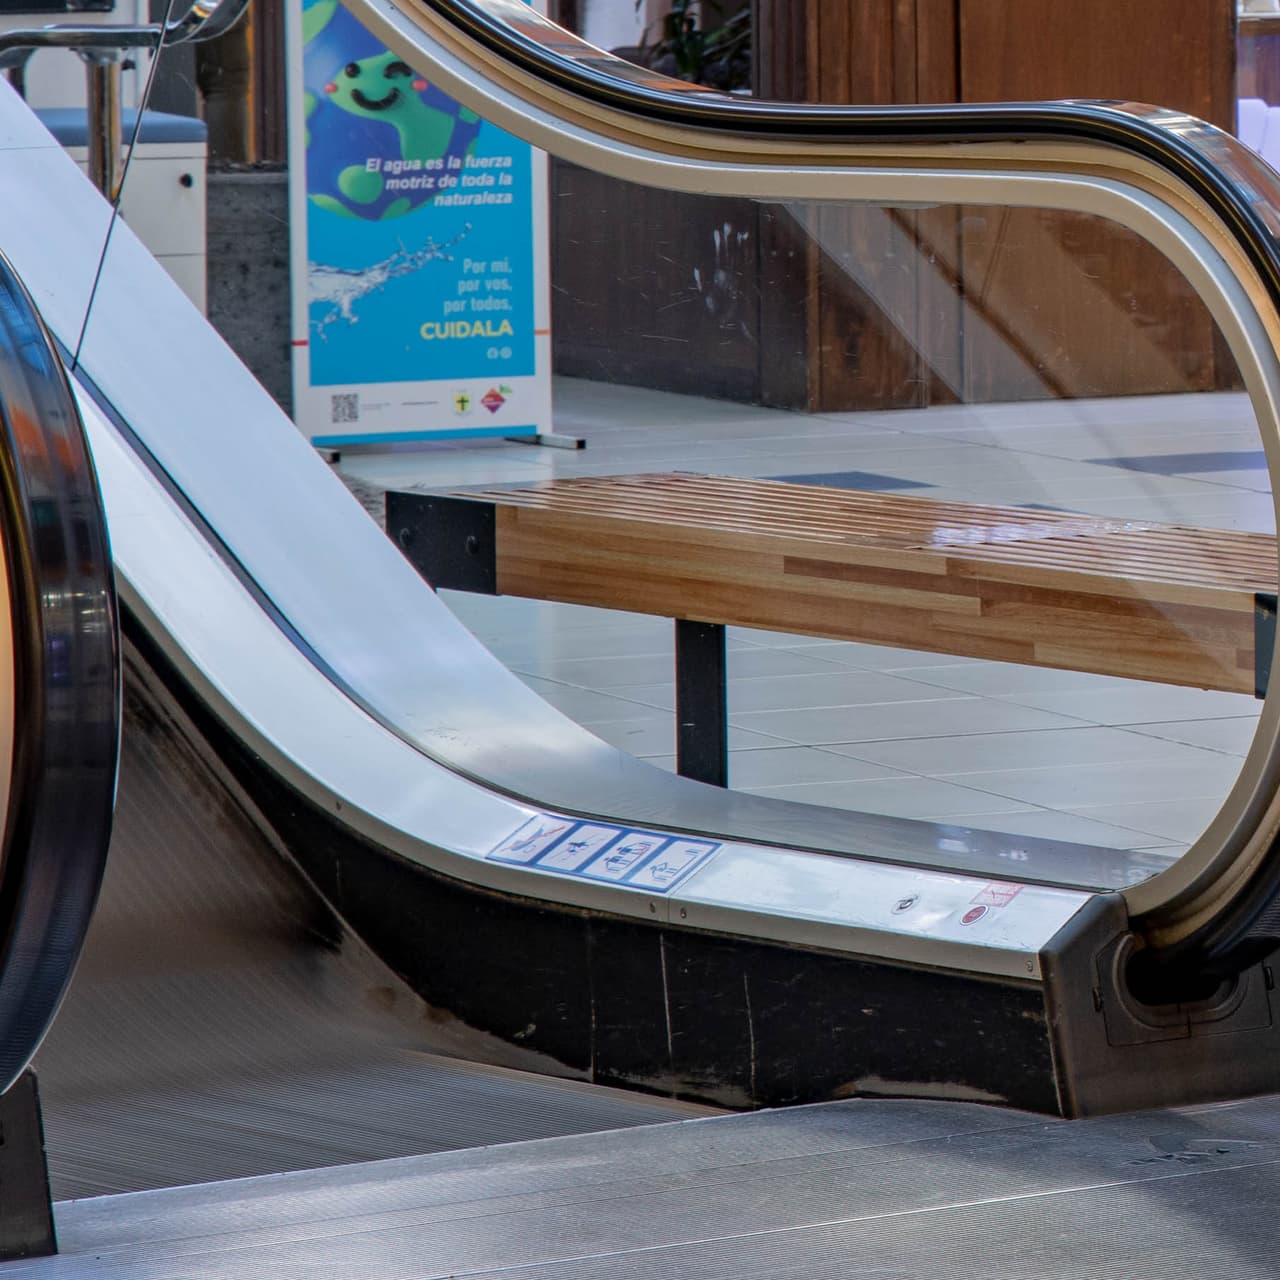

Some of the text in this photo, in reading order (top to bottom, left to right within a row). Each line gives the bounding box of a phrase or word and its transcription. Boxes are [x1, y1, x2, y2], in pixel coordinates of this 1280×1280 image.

[366, 154, 512, 174] El agua es la fuerza
[386, 172, 512, 190] motriz de toda la
[434, 191, 512, 207] naturaleza
[463, 258, 487, 274] Por
[457, 279, 480, 296] por
[443, 300, 466, 317] por
[420, 318, 513, 340] CUIDALA
